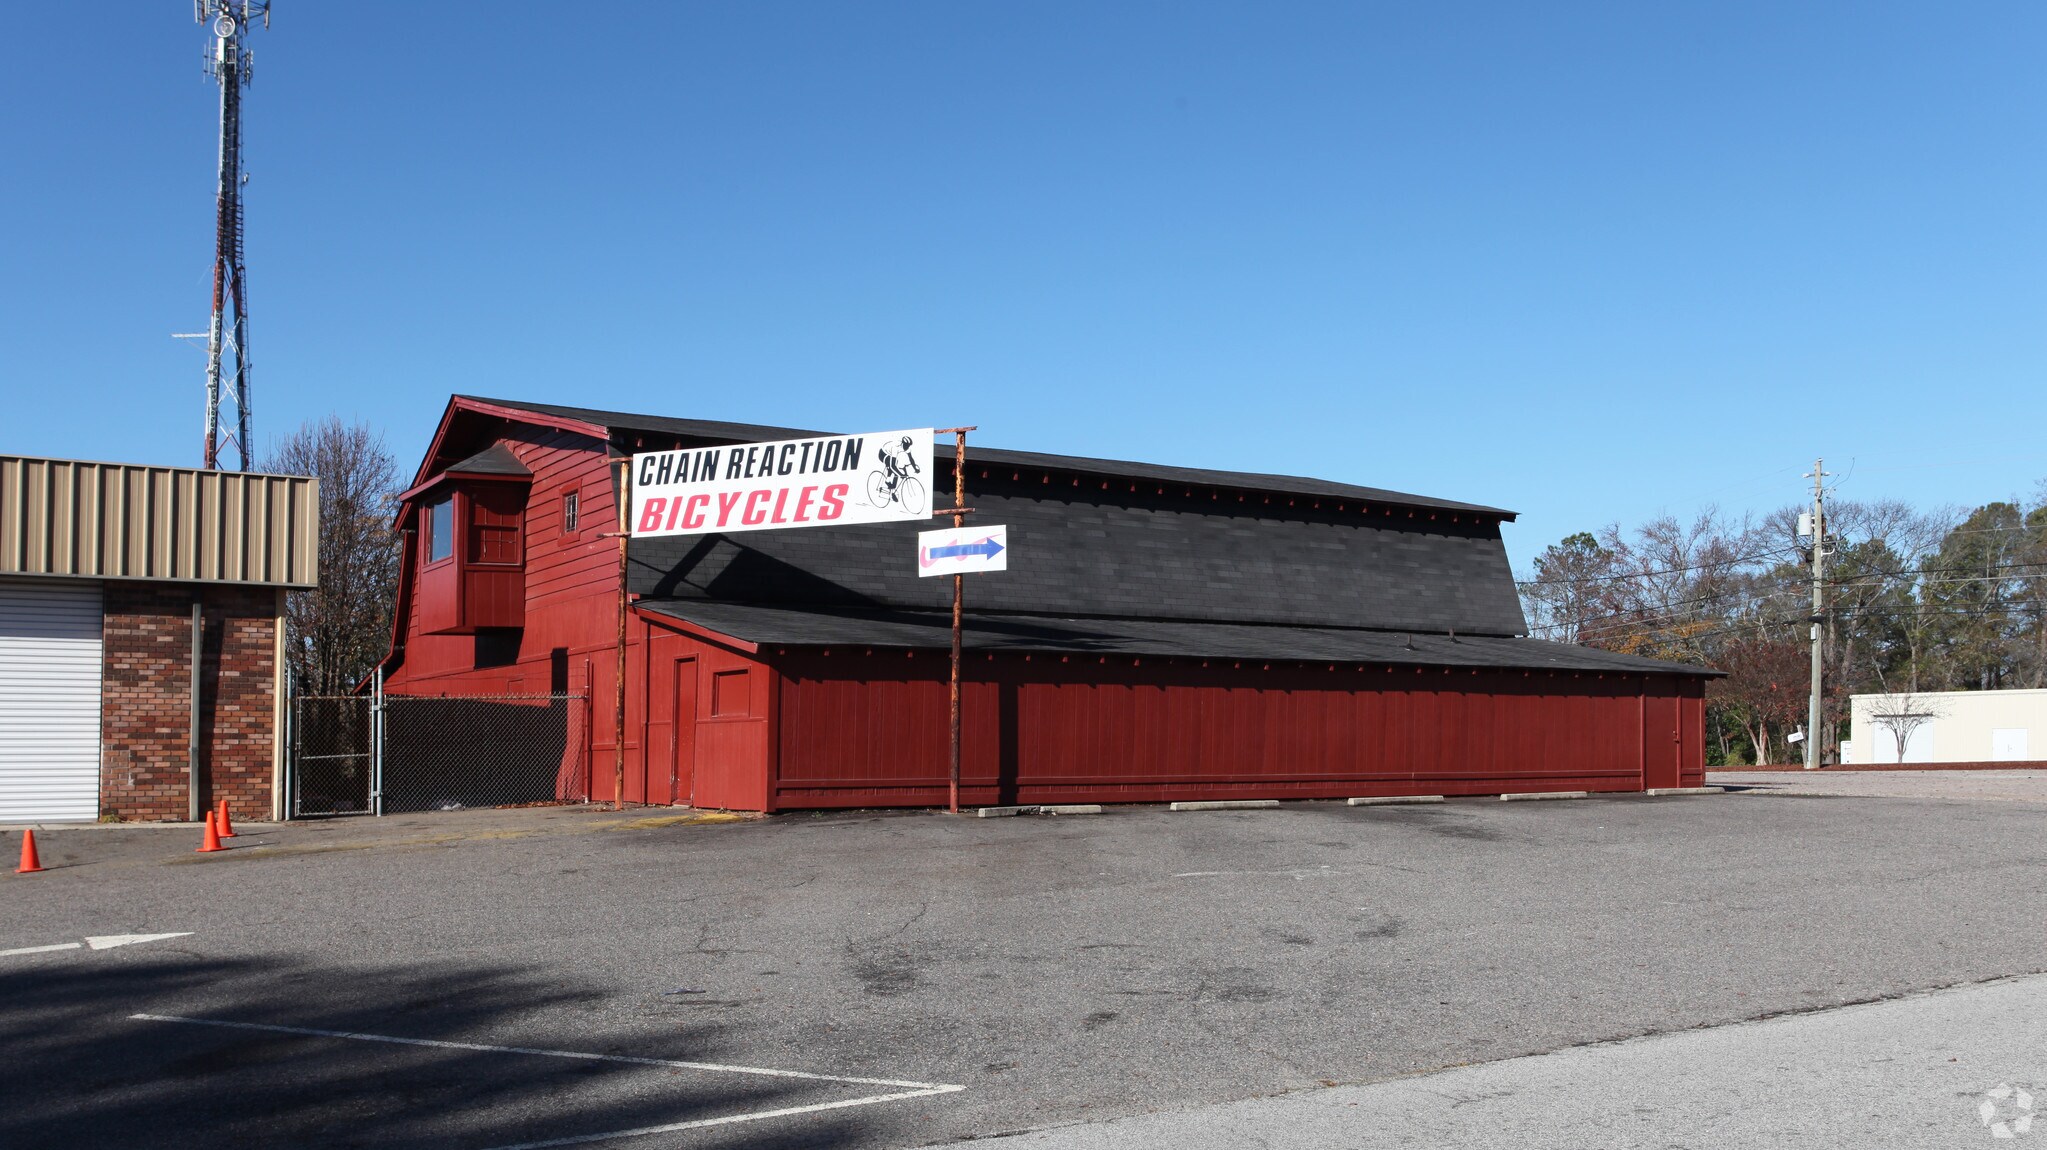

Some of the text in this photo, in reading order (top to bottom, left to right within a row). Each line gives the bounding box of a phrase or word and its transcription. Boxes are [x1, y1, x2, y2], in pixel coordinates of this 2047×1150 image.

[639, 438, 864, 486] CHAIN REACTION
[638, 484, 849, 532] BICYCLES
